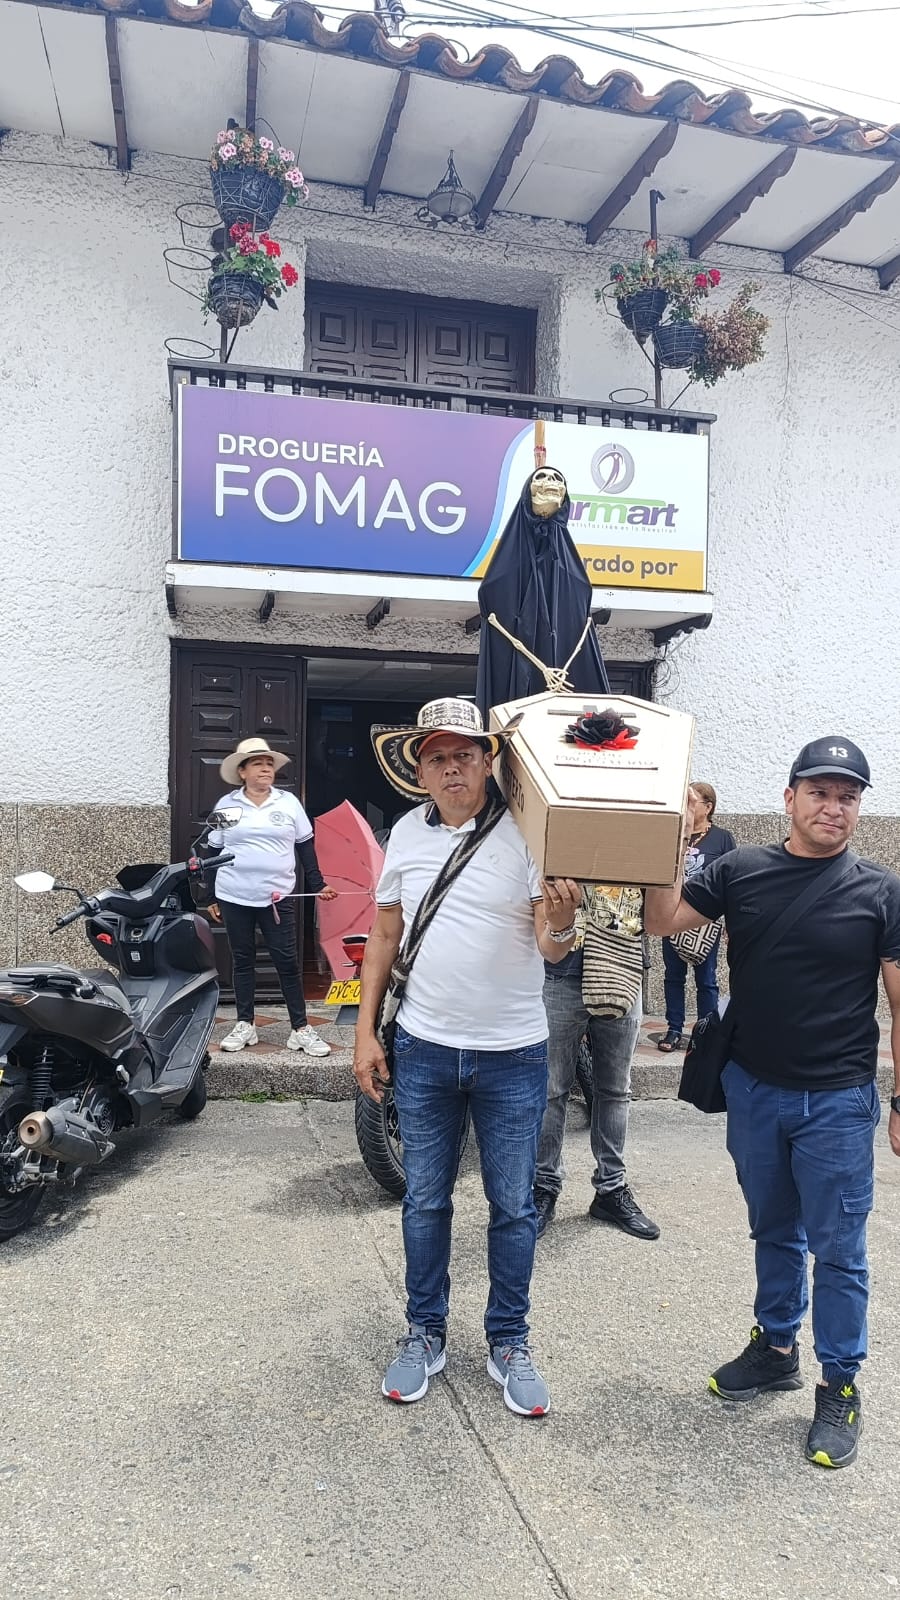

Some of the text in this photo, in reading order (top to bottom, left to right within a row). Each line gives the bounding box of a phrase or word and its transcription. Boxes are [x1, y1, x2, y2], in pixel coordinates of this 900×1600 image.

[218, 433, 384, 468] DROGUERÍA
[215, 462, 467, 535] FOMAG
[583, 554, 678, 579] rado por
[828, 746, 848, 758] 13
